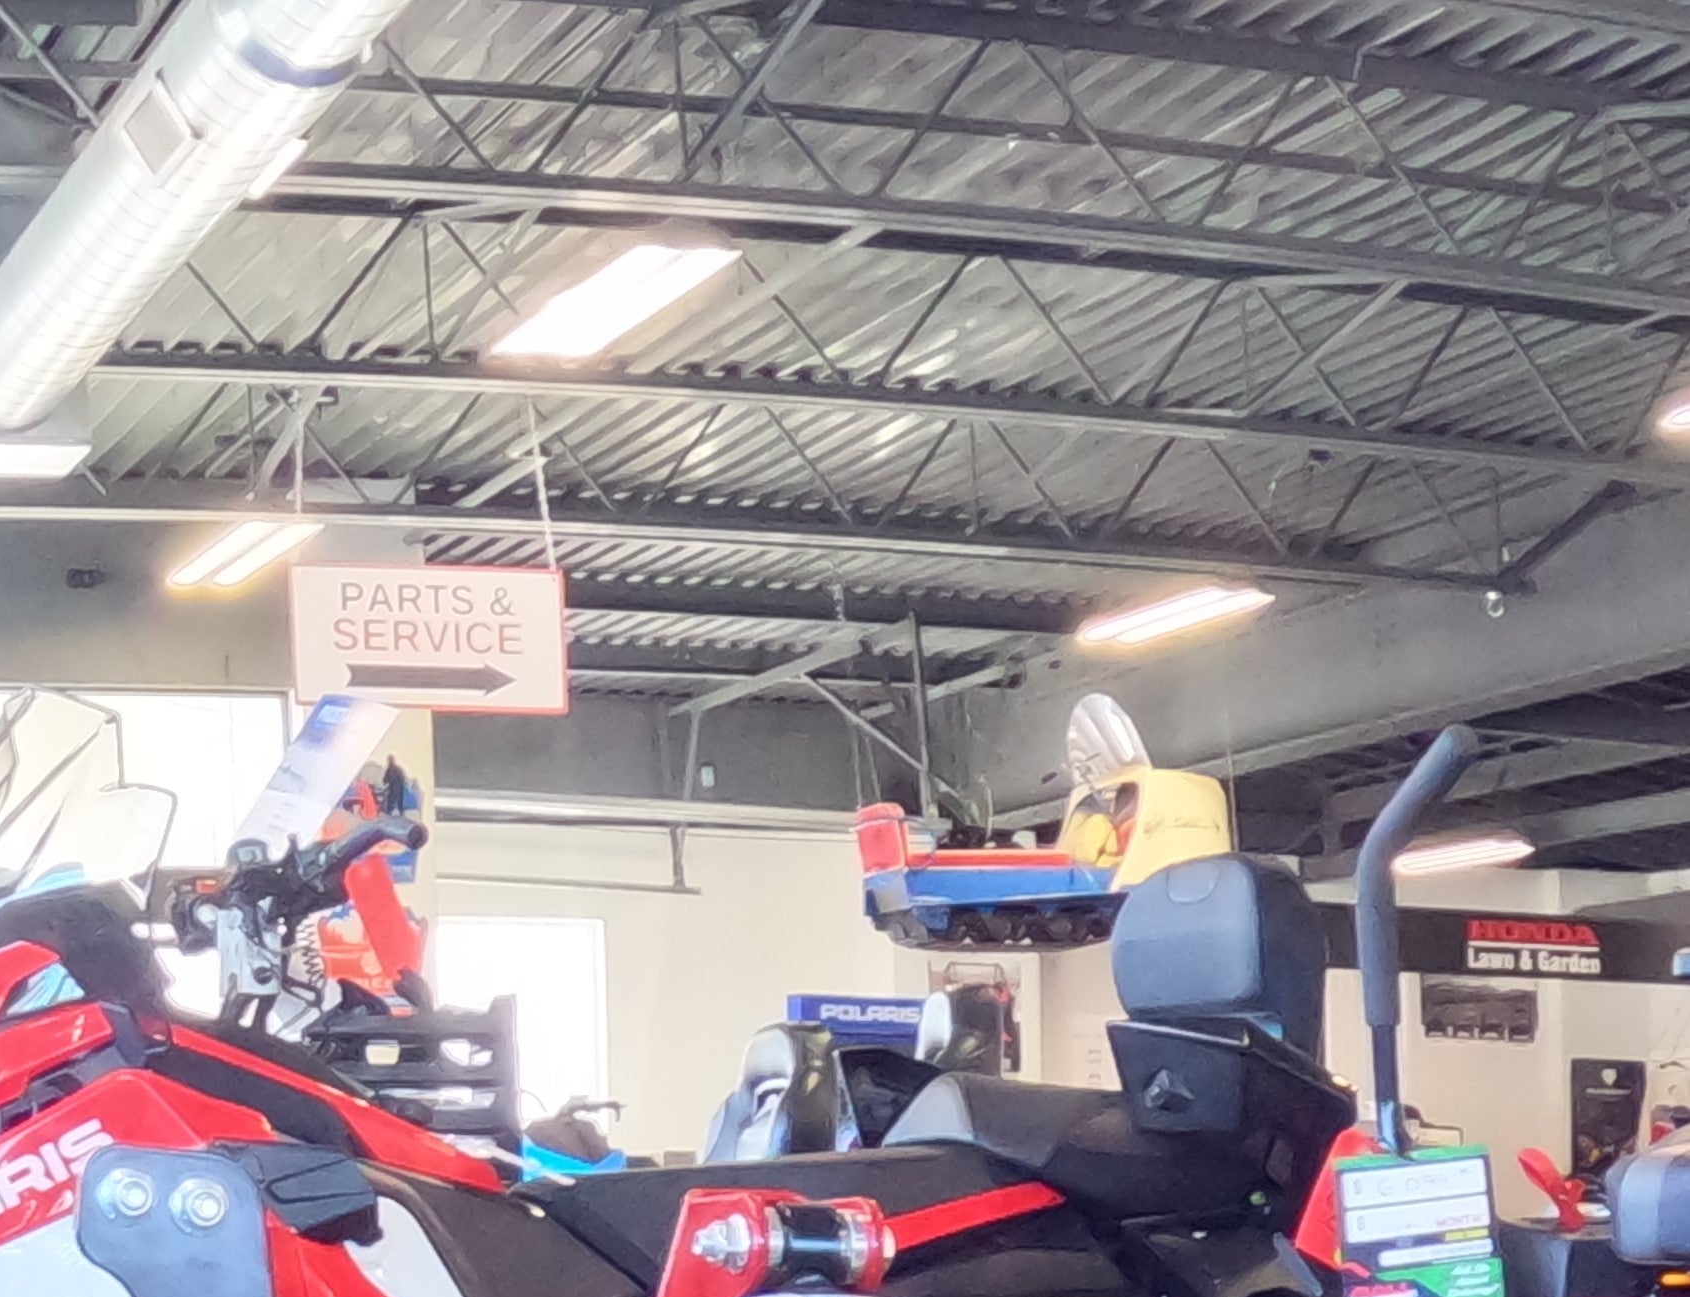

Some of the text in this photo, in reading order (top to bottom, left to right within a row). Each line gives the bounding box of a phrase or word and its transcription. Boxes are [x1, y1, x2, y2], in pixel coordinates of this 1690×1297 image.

[340, 582, 515, 616] PARTS &
[333, 618, 524, 655] SERVICE
[1466, 918, 1600, 945] HONDA
[1468, 948, 1602, 974] Lawn & Garden
[821, 1004, 920, 1023] POLARIS
